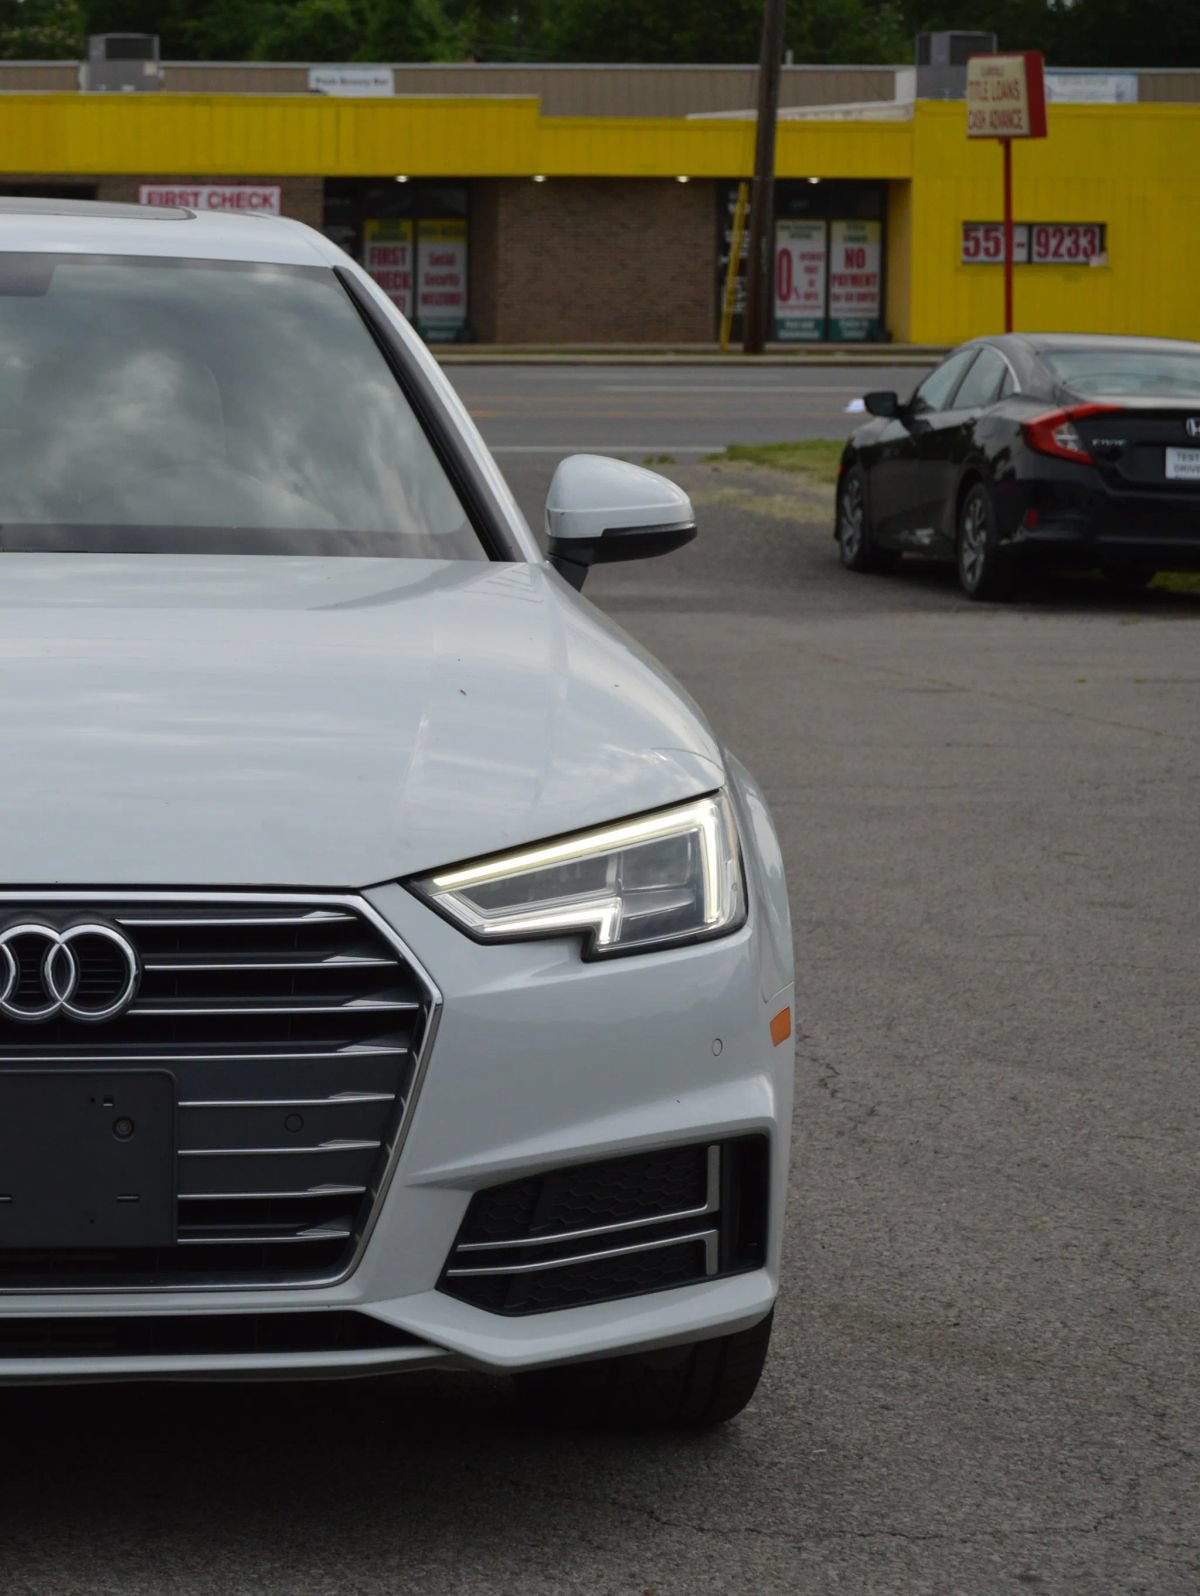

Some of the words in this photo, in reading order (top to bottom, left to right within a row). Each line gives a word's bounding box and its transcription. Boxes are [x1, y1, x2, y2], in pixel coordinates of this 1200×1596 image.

[991, 80, 1021, 101] LOANS
[989, 109, 1025, 130] ADVANCE
[147, 190, 202, 208] FIRST
[207, 190, 274, 209] CHECK
[844, 247, 866, 269] NO
[832, 272, 878, 288] PAYMENT
